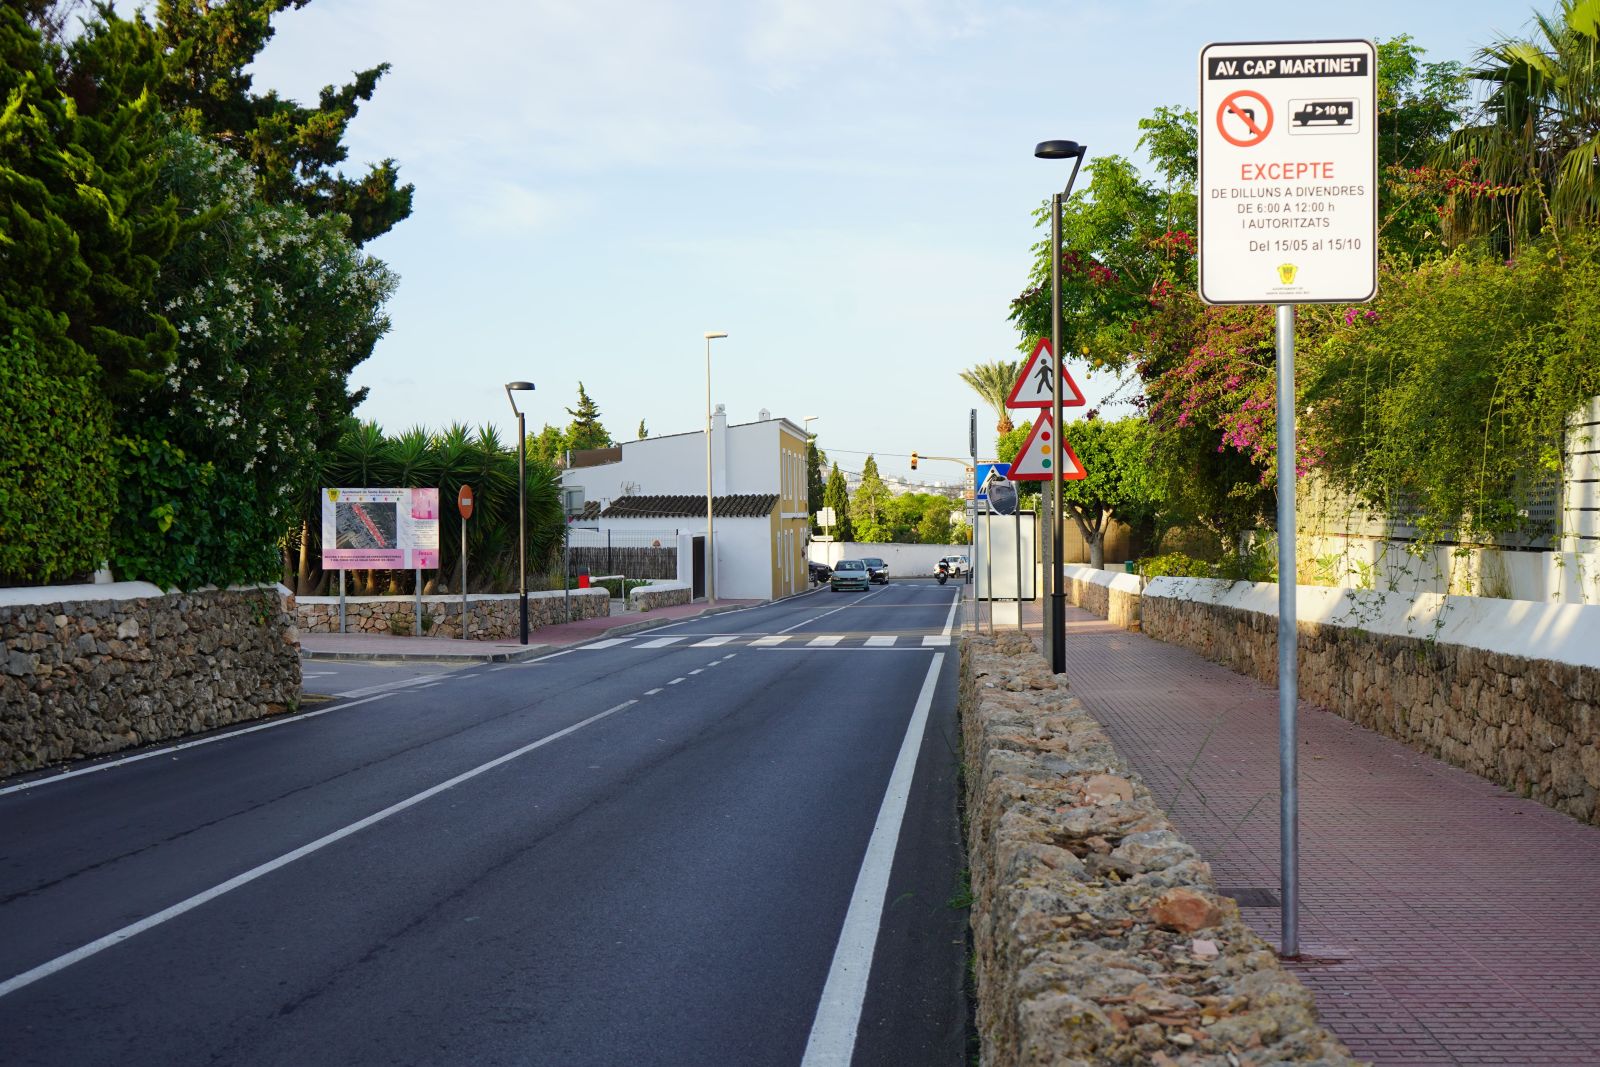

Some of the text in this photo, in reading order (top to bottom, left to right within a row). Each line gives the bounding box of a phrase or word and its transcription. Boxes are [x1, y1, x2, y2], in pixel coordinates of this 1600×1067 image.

[1215, 57, 1361, 76] AV. CAP MARTINET
[1241, 162, 1334, 180] EXCEPTE
[1211, 186, 1364, 199] DE DILLUNS A DIVENDRES
[1237, 202, 1335, 214] DE 6:00 A 12:00 h
[1249, 218, 1330, 229] AUTORITZATS
[1249, 238, 1361, 252] Del 15/05 al 15/10
